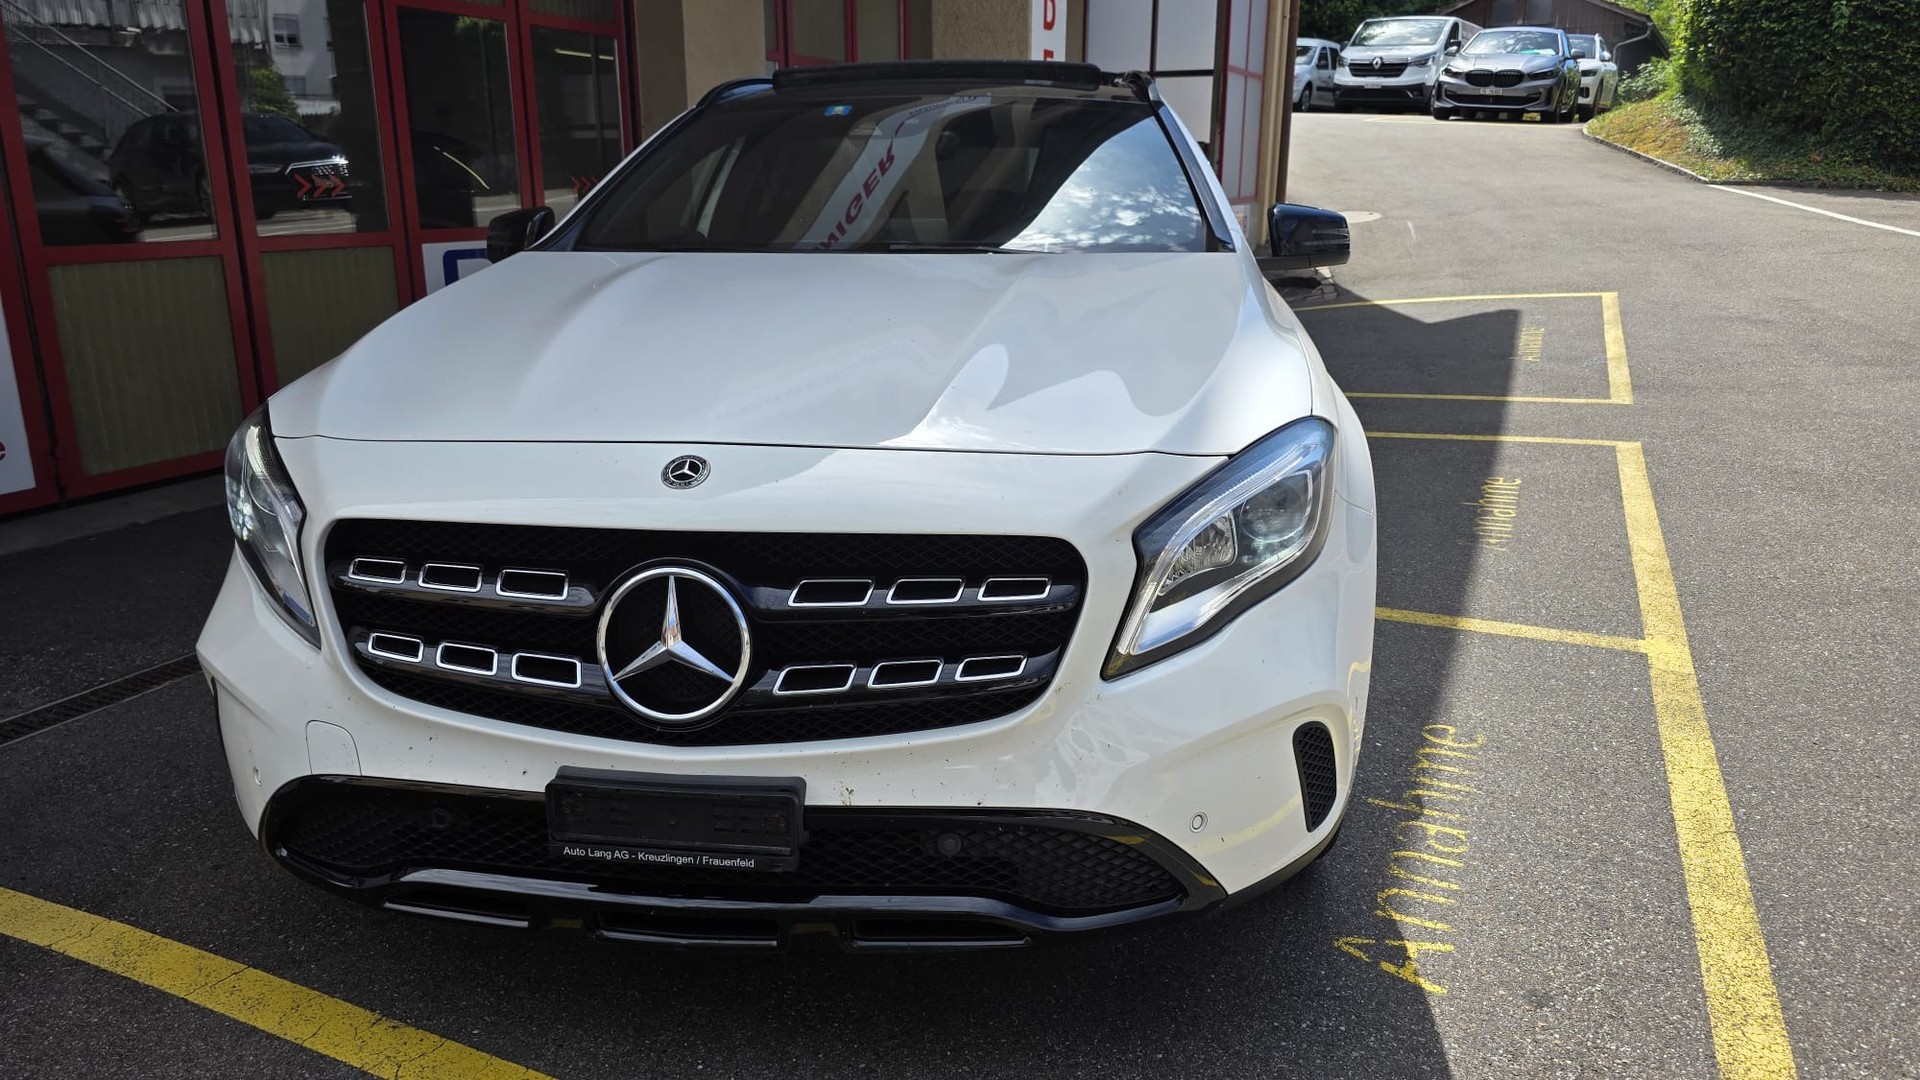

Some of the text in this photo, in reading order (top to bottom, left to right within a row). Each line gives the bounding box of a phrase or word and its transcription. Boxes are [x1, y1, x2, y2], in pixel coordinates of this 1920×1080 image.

[1456, 476, 1522, 551] Annahme
[563, 846, 586, 856] Auto
[588, 848, 612, 860] Lang
[613, 850, 630, 860] AG
[638, 852, 694, 865] Kreuzlingen
[696, 856, 700, 865] /
[702, 856, 755, 868] Frauenfeld
[1332, 723, 1486, 995] Annahme
